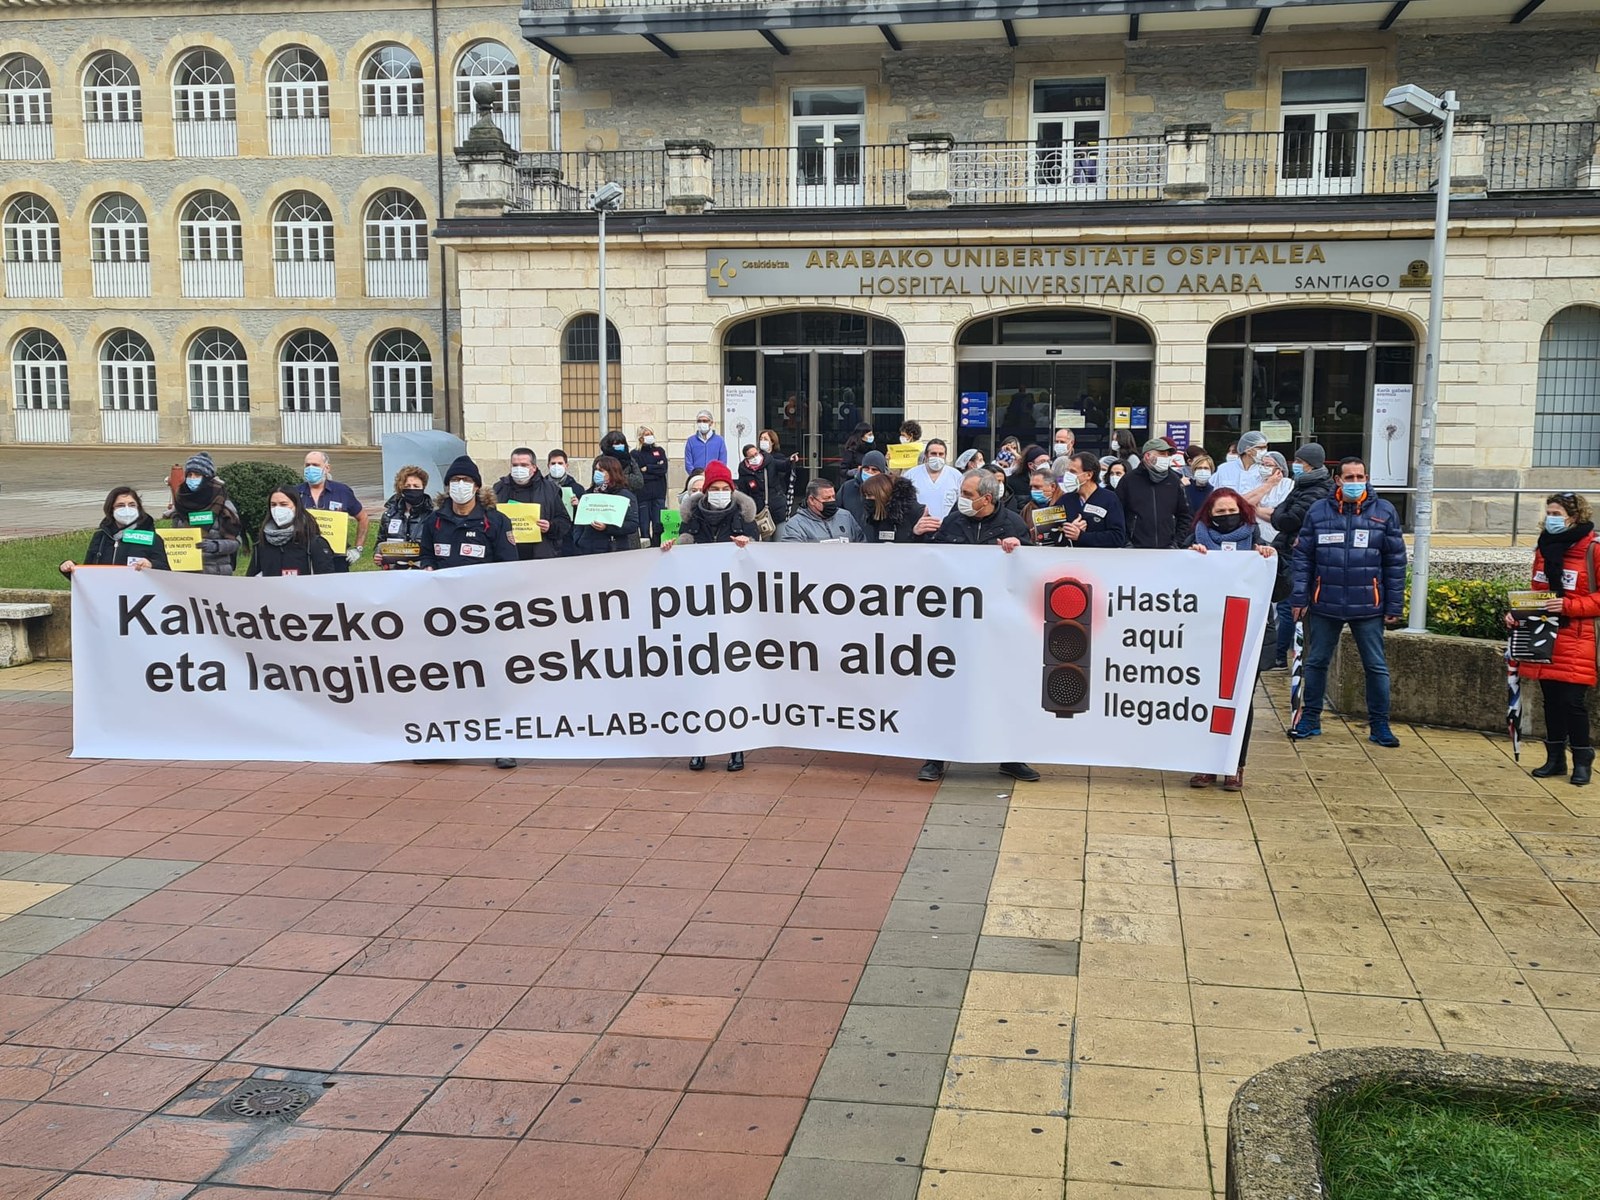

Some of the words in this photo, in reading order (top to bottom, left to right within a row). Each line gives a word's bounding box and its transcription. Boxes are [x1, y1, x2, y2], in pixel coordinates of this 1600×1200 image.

[742, 259, 790, 269] Osakidetza
[805, 249, 933, 269] ARABAKO
[943, 246, 1156, 268] UNIBERTSITATE
[1167, 243, 1326, 267] OSPITALEA
[859, 275, 970, 295] HOSPITAL
[980, 274, 1165, 295] UNIVERSITARIO
[1176, 273, 1263, 293] ARABA
[1295, 274, 1390, 290] SANTIAGO
[117, 594, 404, 642] Kalitatezko
[423, 587, 630, 638] osasun
[650, 571, 984, 629] publikoaren
[1107, 585, 1199, 617] ¡Hasta
[1122, 623, 1185, 655] aquí
[145, 652, 227, 692] eta
[245, 652, 486, 704] langileen
[505, 632, 820, 684] eskubideen
[839, 632, 957, 679] alde
[1104, 657, 1201, 686] hemos
[404, 703, 900, 744] SATSE-ELA-LAB-CCOO-UGT-ESK
